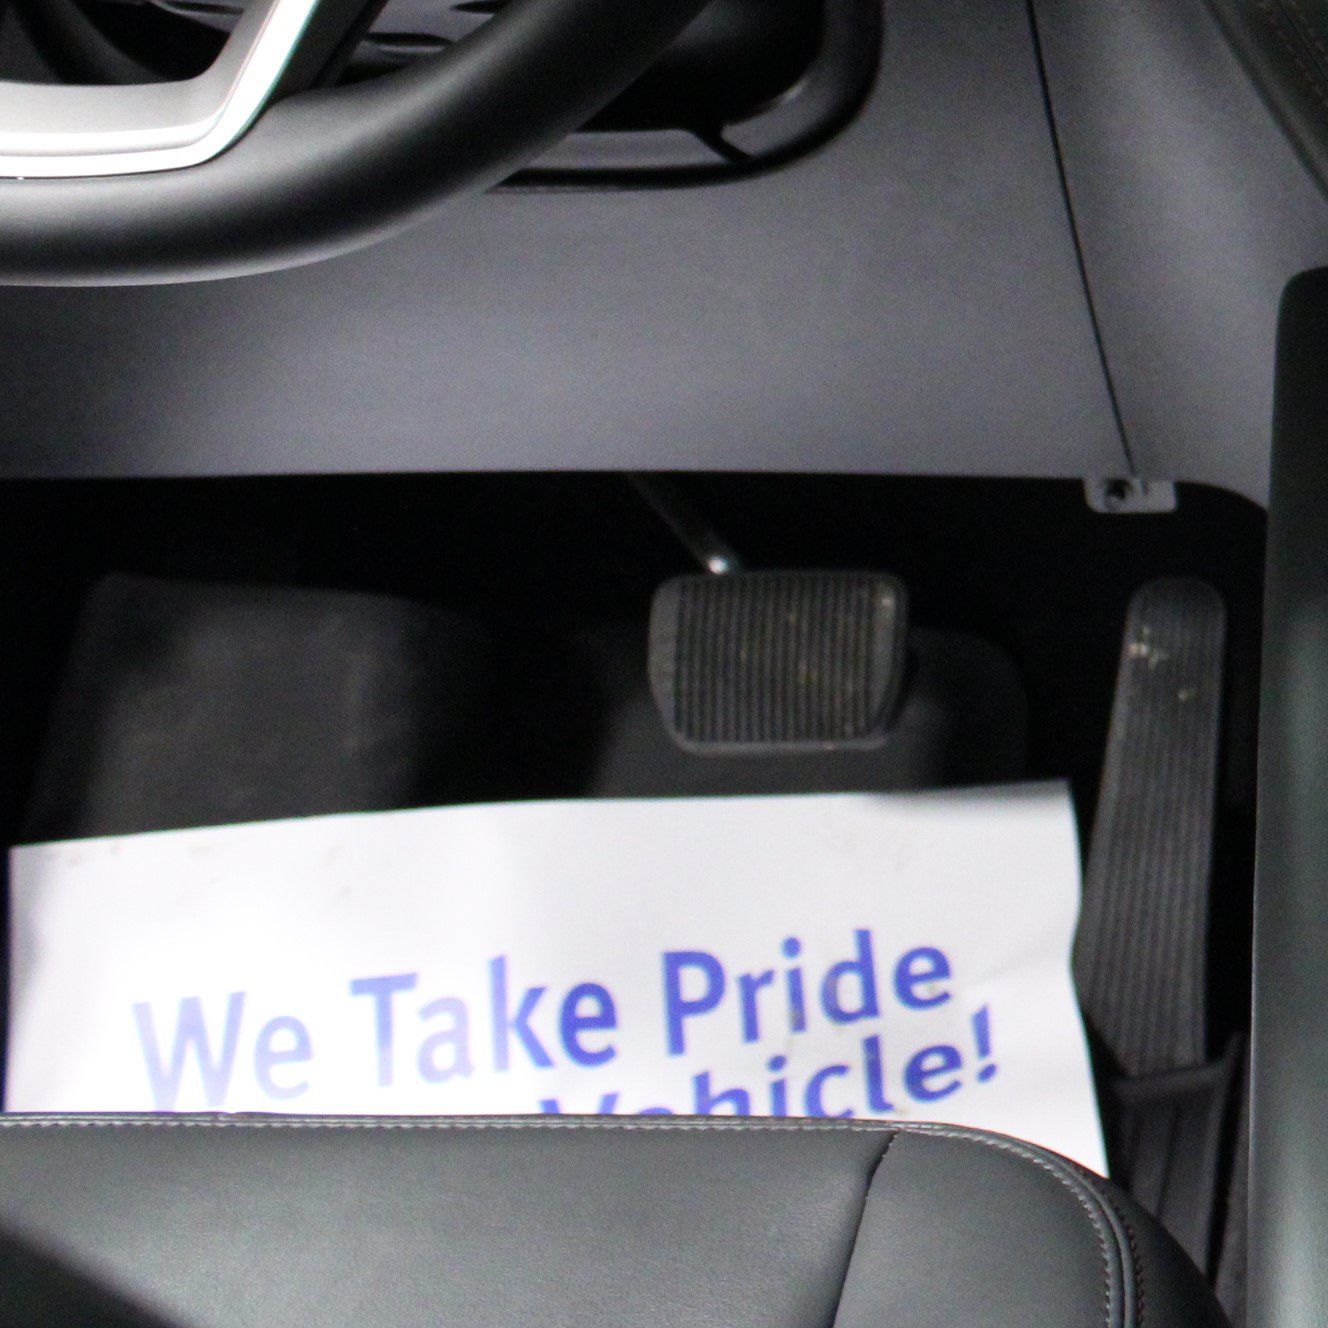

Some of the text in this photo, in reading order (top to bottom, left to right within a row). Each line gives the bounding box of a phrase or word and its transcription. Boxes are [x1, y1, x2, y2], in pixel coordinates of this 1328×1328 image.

[133, 928, 953, 1113] We Take Pride
[538, 1002, 998, 1117] hicle!
